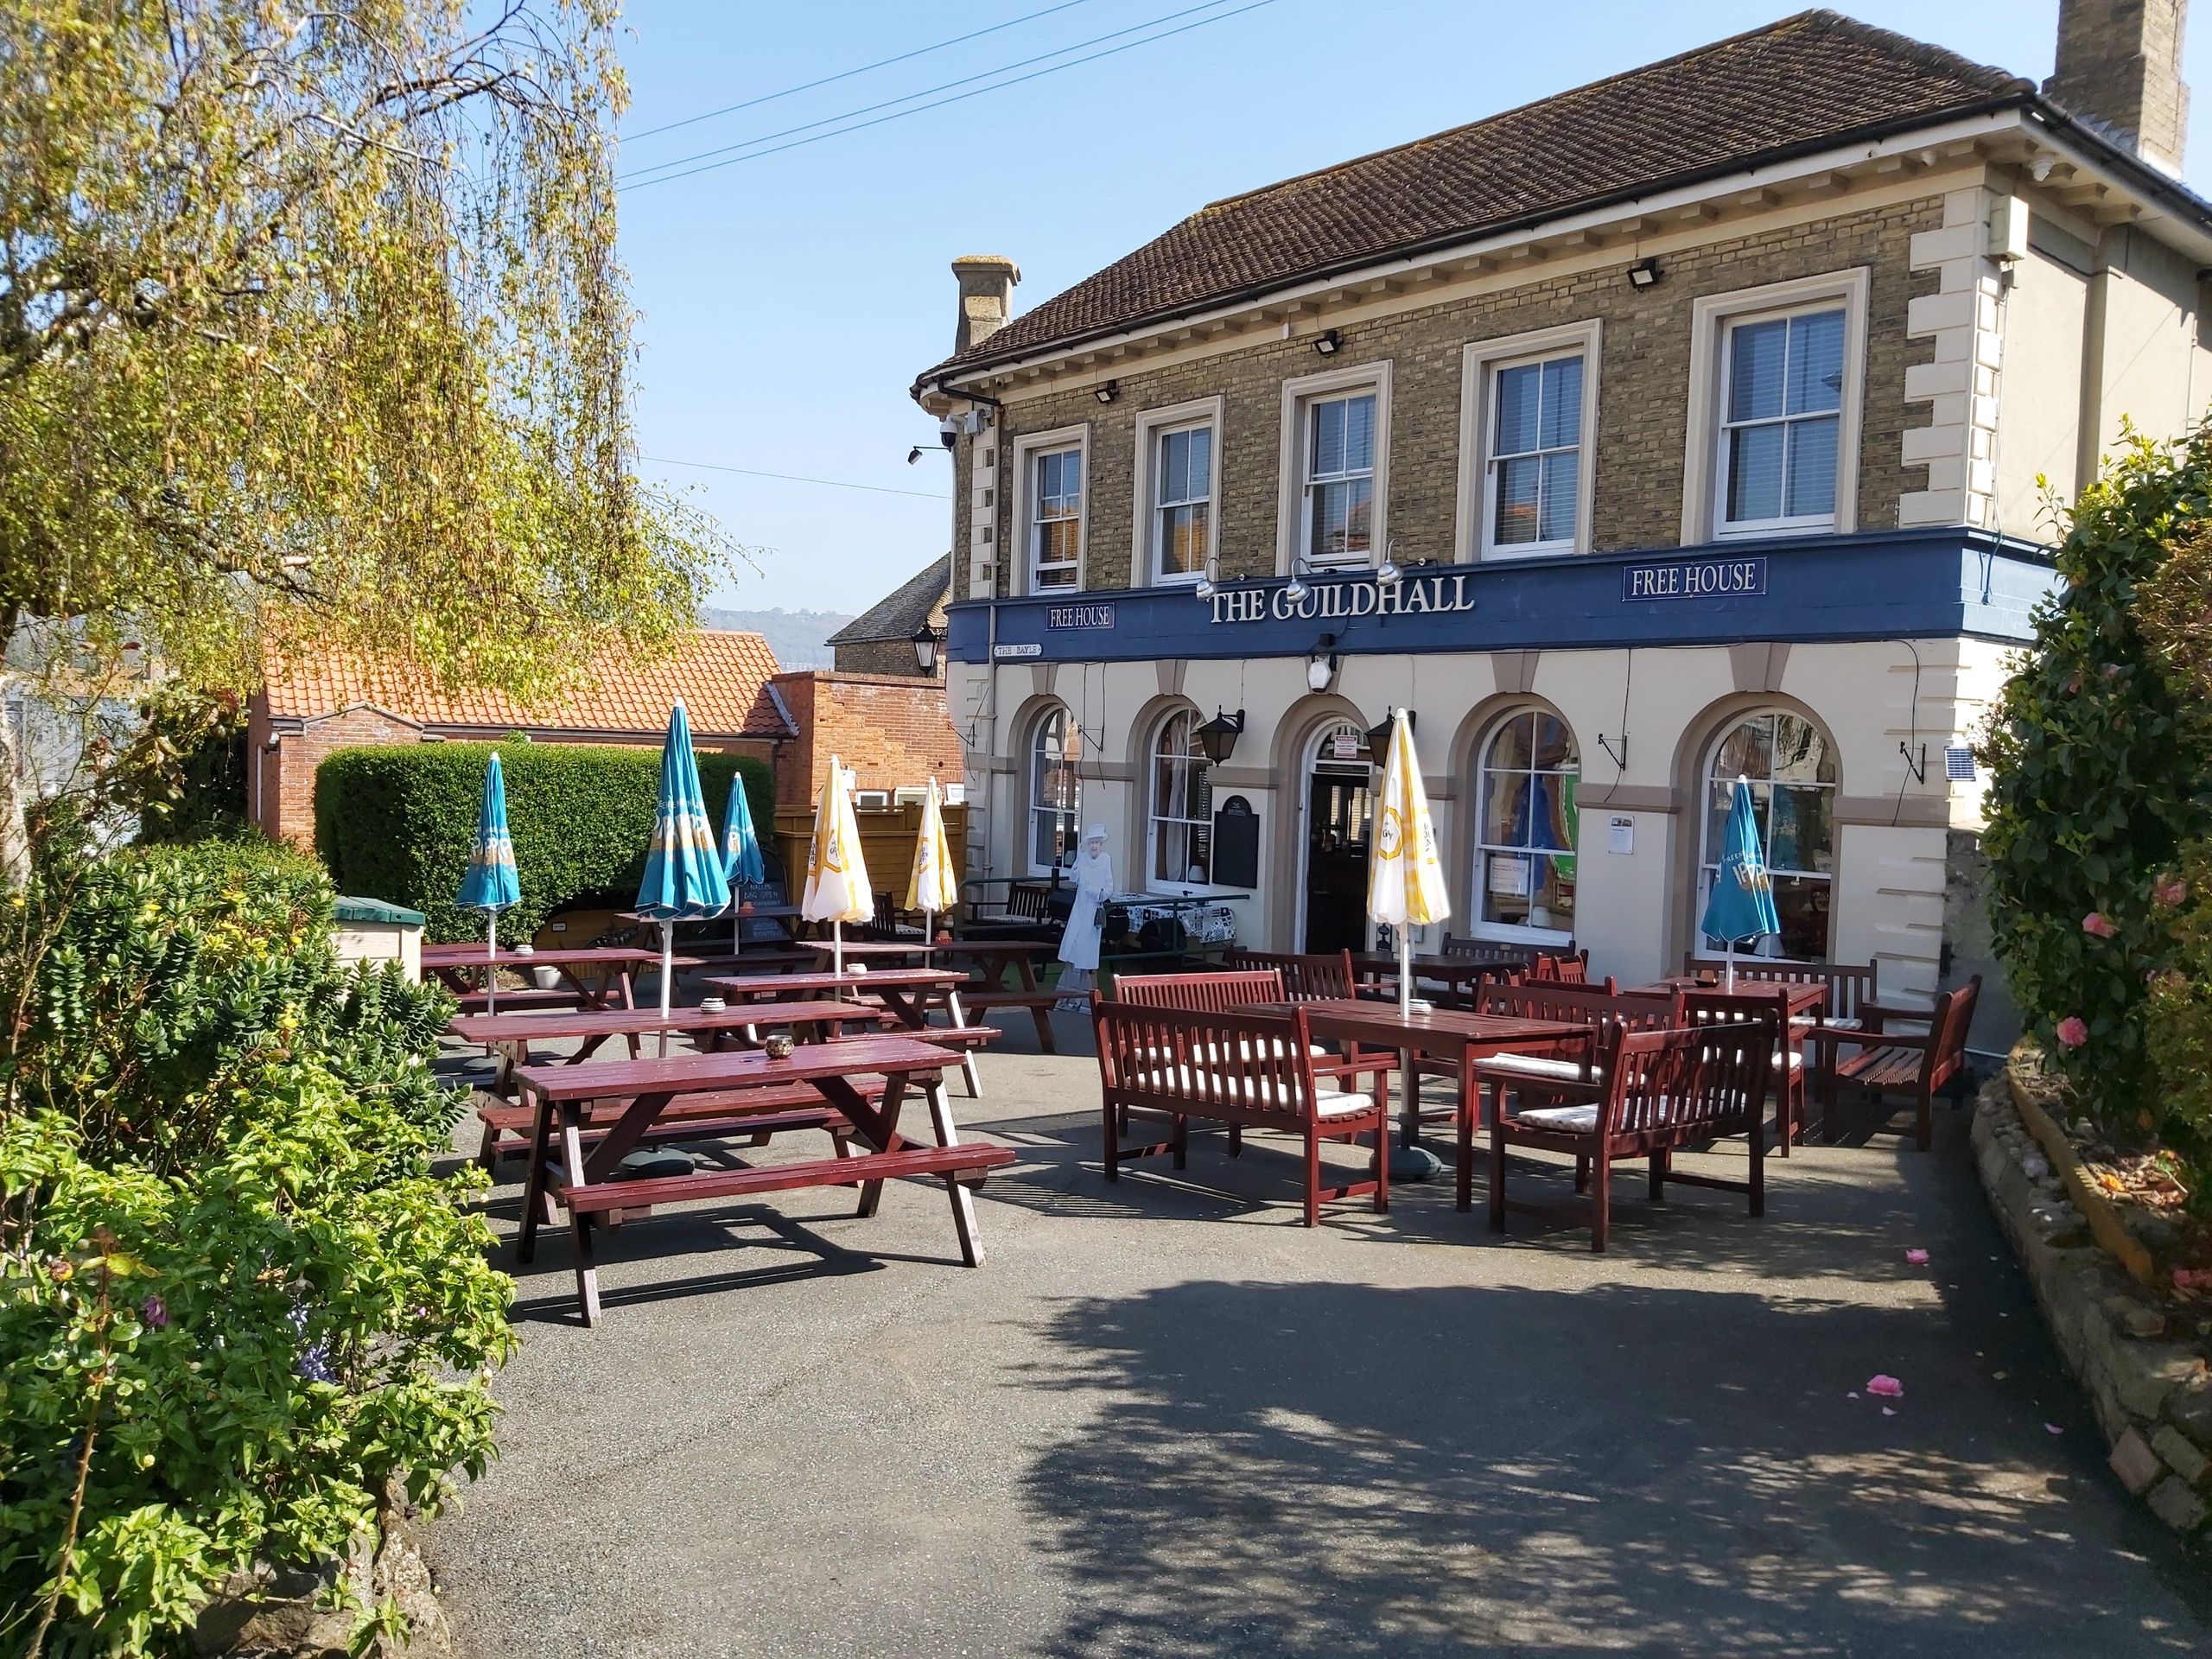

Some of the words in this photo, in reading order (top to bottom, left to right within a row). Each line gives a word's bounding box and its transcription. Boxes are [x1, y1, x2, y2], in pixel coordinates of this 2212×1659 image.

[1630, 568, 1680, 596] FREE
[1683, 563, 1757, 594] HOUSE
[1208, 588, 1268, 624] THE
[1272, 575, 1475, 620] GUILDHALL
[1050, 607, 1074, 627] FREE
[1075, 606, 1109, 626] HOUSE
[997, 646, 1012, 655] THE
[1016, 645, 1037, 654] BAYLE
